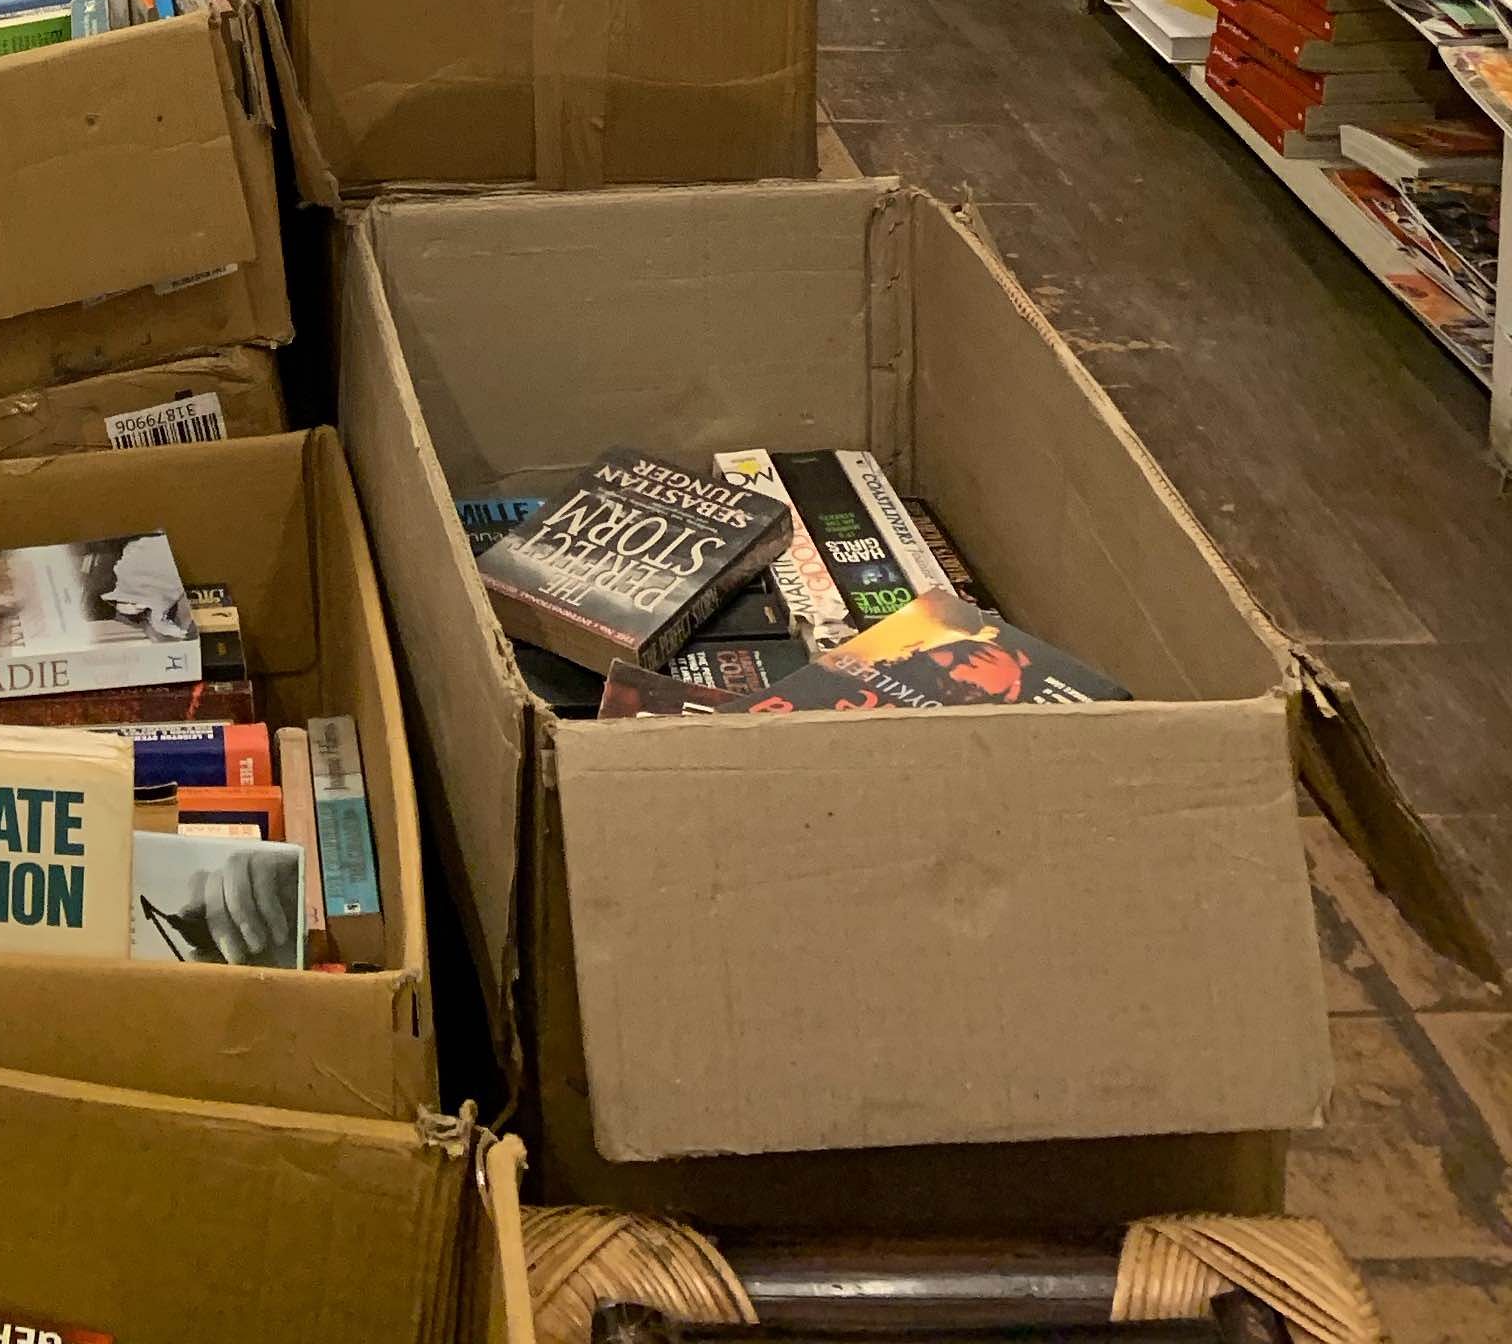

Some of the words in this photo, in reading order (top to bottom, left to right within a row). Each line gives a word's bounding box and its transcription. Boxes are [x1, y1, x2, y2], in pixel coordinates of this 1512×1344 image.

[115, 402, 196, 435] 31879906
[593, 467, 756, 529] SEBASTIAN
[632, 459, 753, 505] JUNGER
[543, 488, 726, 577] STORM
[537, 577, 590, 607] THE
